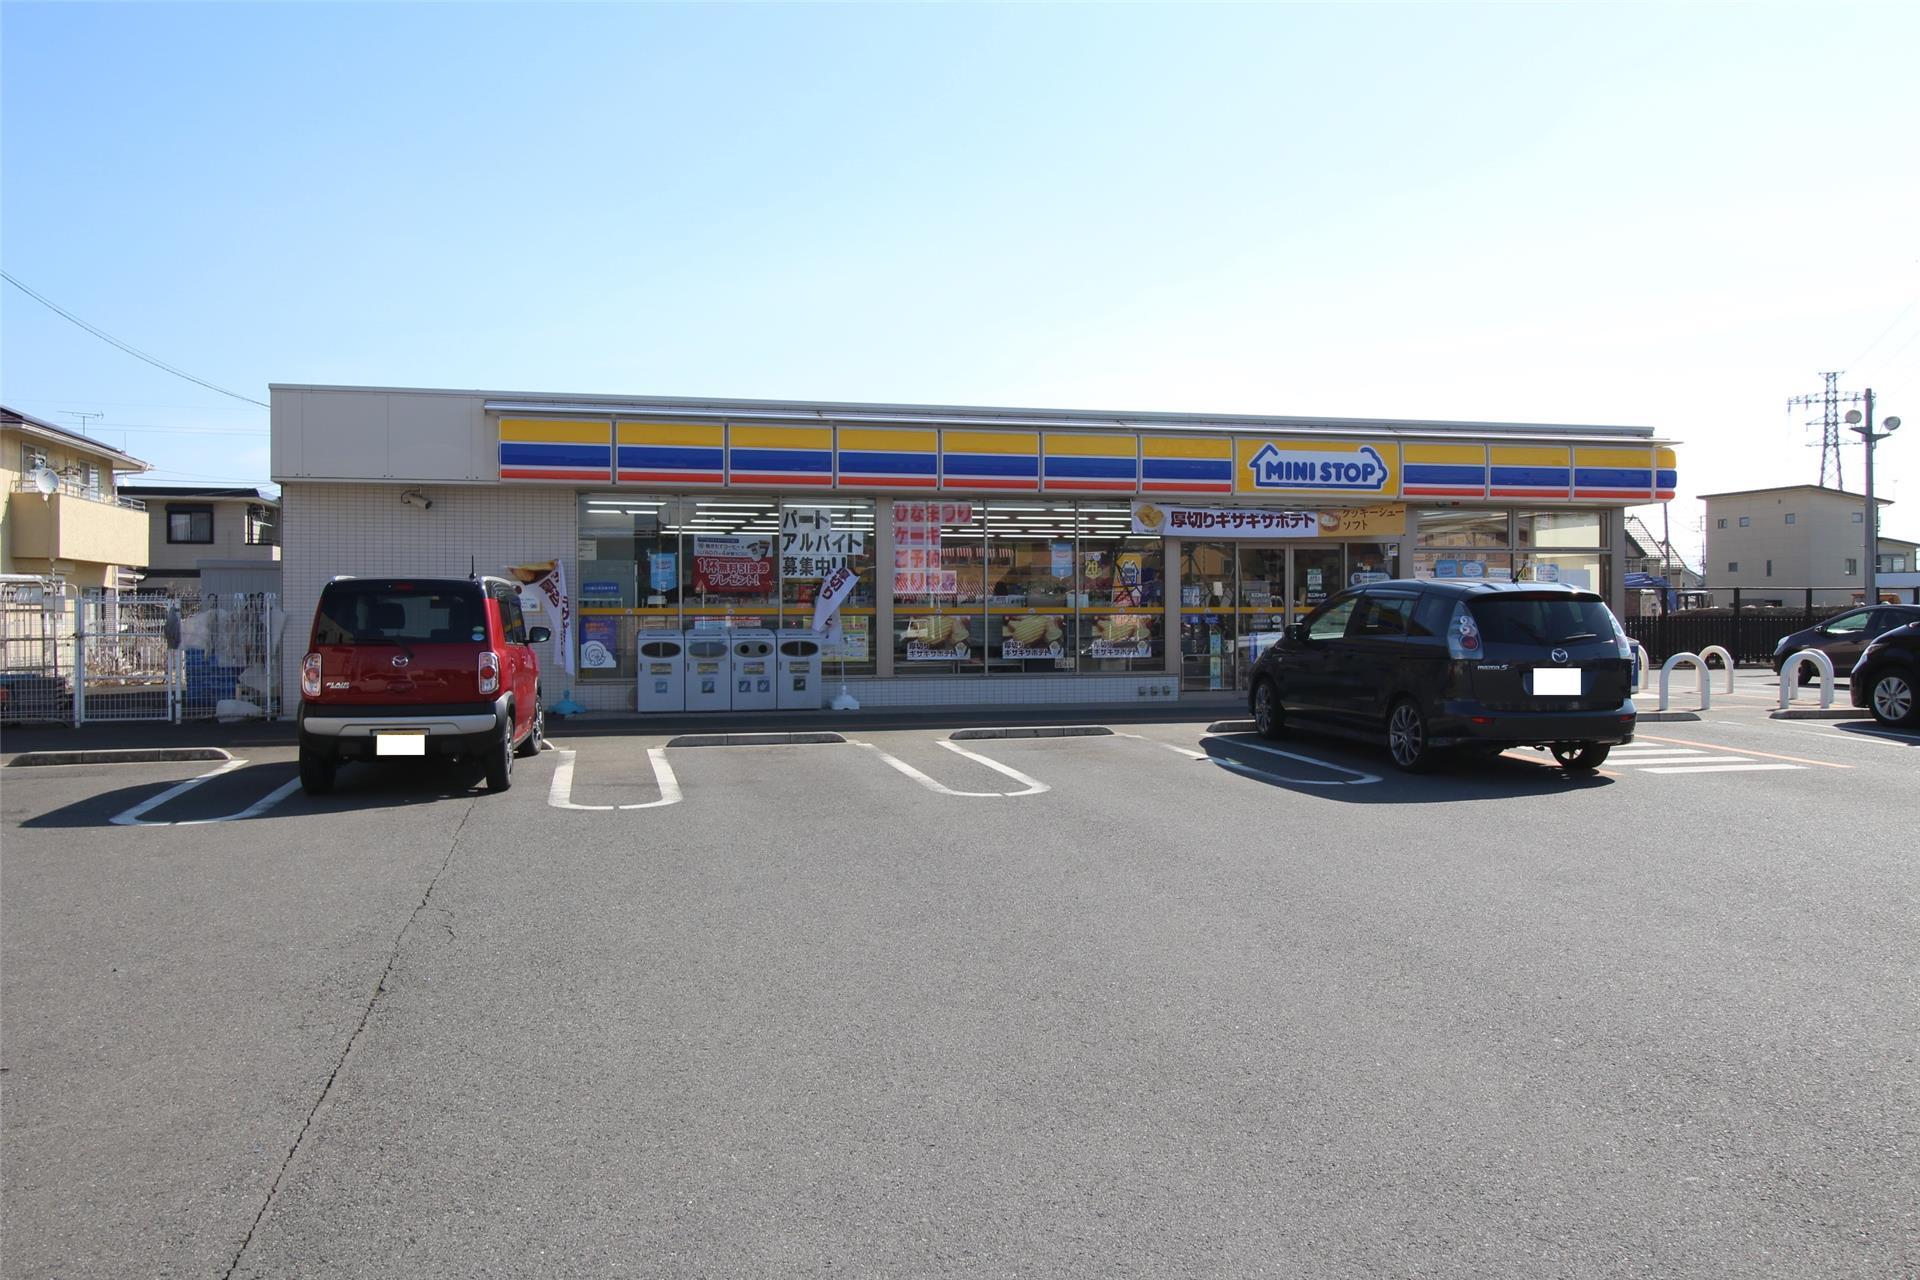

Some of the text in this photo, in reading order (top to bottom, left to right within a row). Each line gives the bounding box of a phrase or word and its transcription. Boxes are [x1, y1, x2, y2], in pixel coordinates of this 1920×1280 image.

[1265, 461, 1376, 482] MINI STOP
[783, 510, 830, 529] パート
[895, 504, 971, 523] ひなまつり
[1342, 520, 1368, 531] ソフト
[783, 533, 862, 552] アルバイト
[895, 526, 940, 545] ケーキ
[697, 557, 770, 574] 1杯無料引換券
[708, 574, 760, 586] プレゼント!
